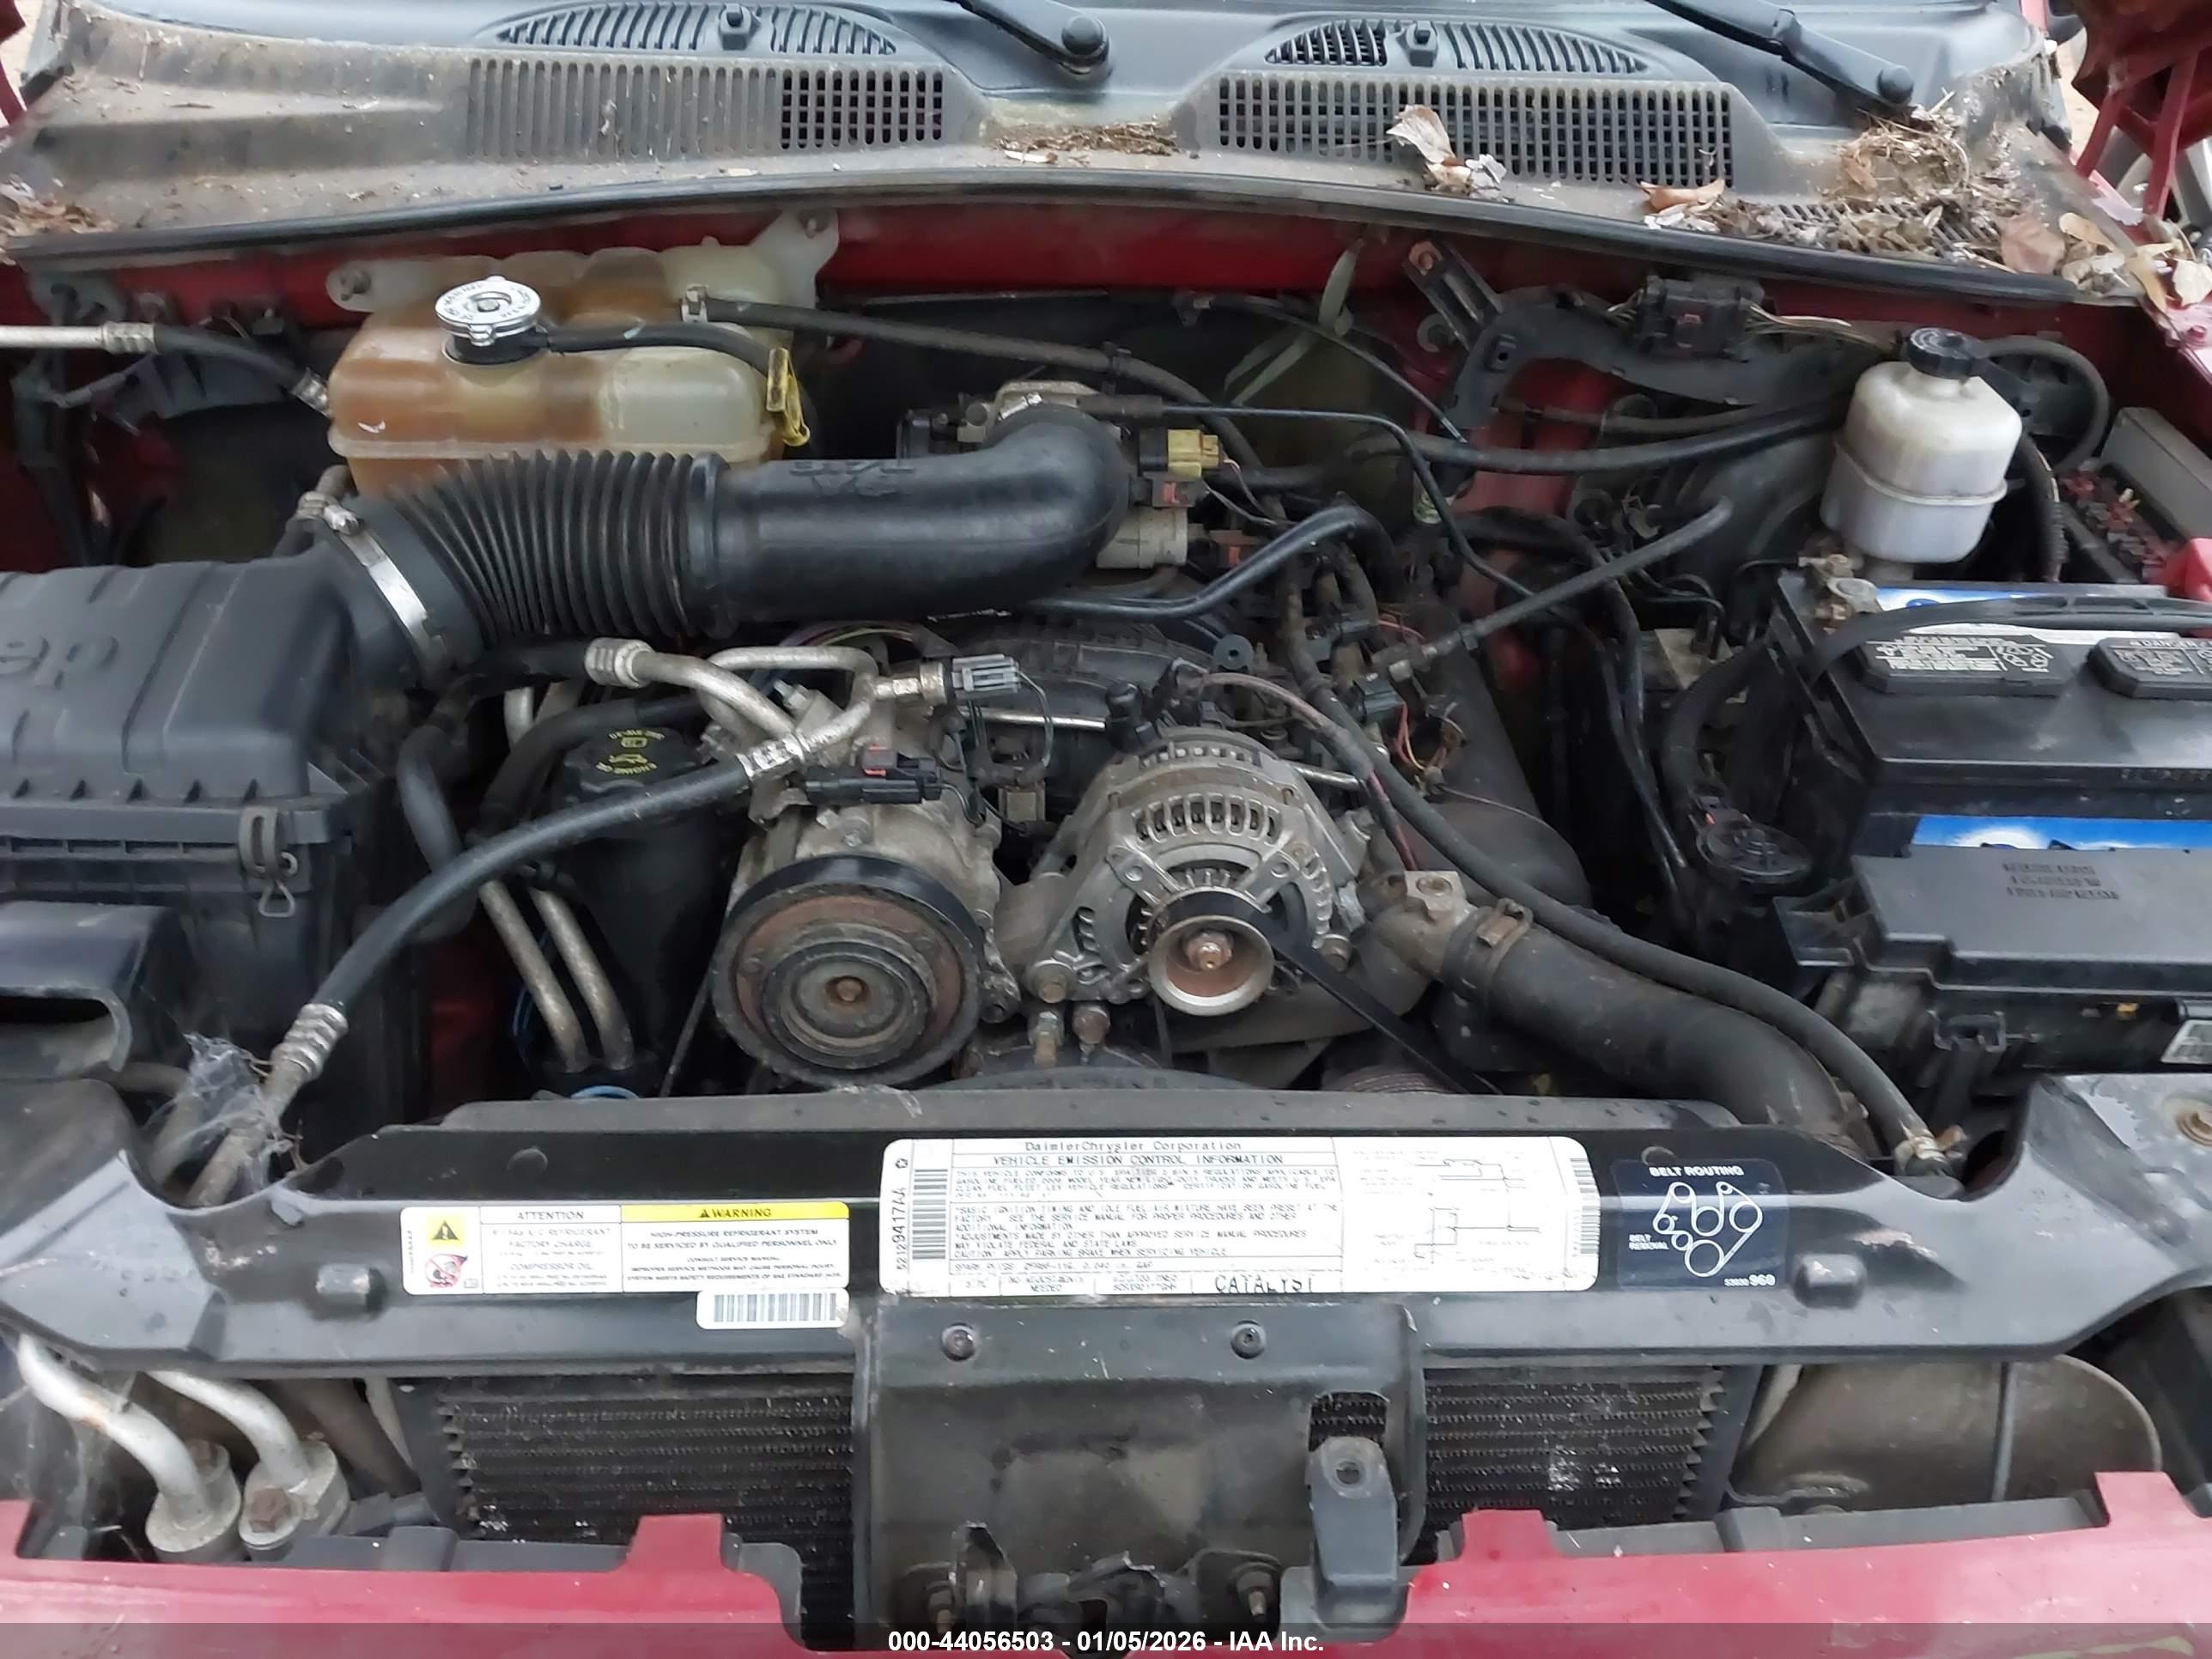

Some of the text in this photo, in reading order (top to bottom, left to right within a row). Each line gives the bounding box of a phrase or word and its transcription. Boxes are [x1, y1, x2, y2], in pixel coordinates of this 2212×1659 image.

[1025, 1141, 1242, 1154] DaimlerChrysler Corporation
[994, 1154, 1284, 1165] VEHICLE EMISSION CONTROL INFORMATION
[1649, 1166, 1745, 1176] BELT ROUTING
[518, 1211, 584, 1219] ATTENTION
[712, 1208, 771, 1218] WARNING
[1629, 1234, 1651, 1243] BELT
[1214, 1274, 1315, 1293] CATALYST
